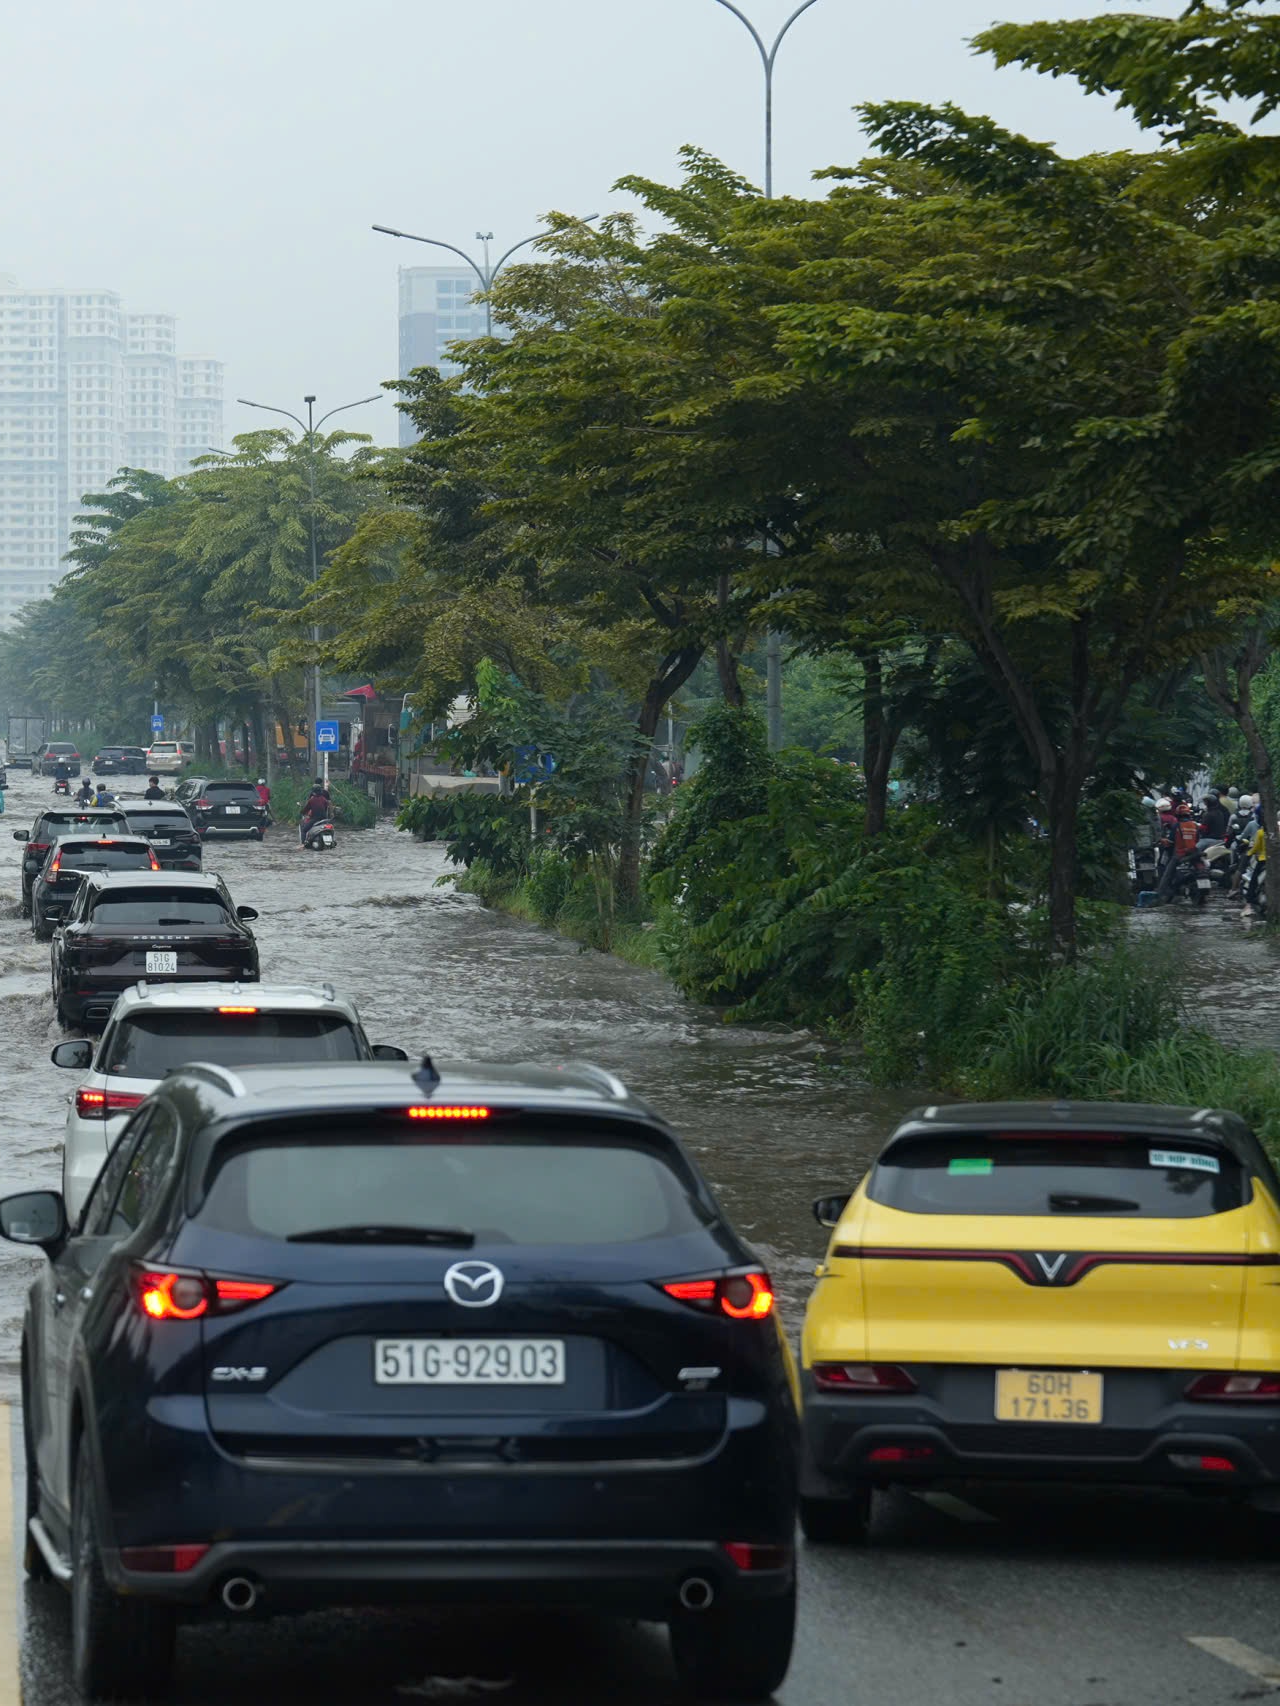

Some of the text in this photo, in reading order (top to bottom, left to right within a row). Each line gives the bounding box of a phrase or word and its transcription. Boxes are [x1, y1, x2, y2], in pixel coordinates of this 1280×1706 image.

[153, 953, 170, 962] 51G
[381, 1344, 557, 1378] 51G-929.03
[1027, 1374, 1072, 1395] 60H
[1011, 1397, 1089, 1419] 171.36
